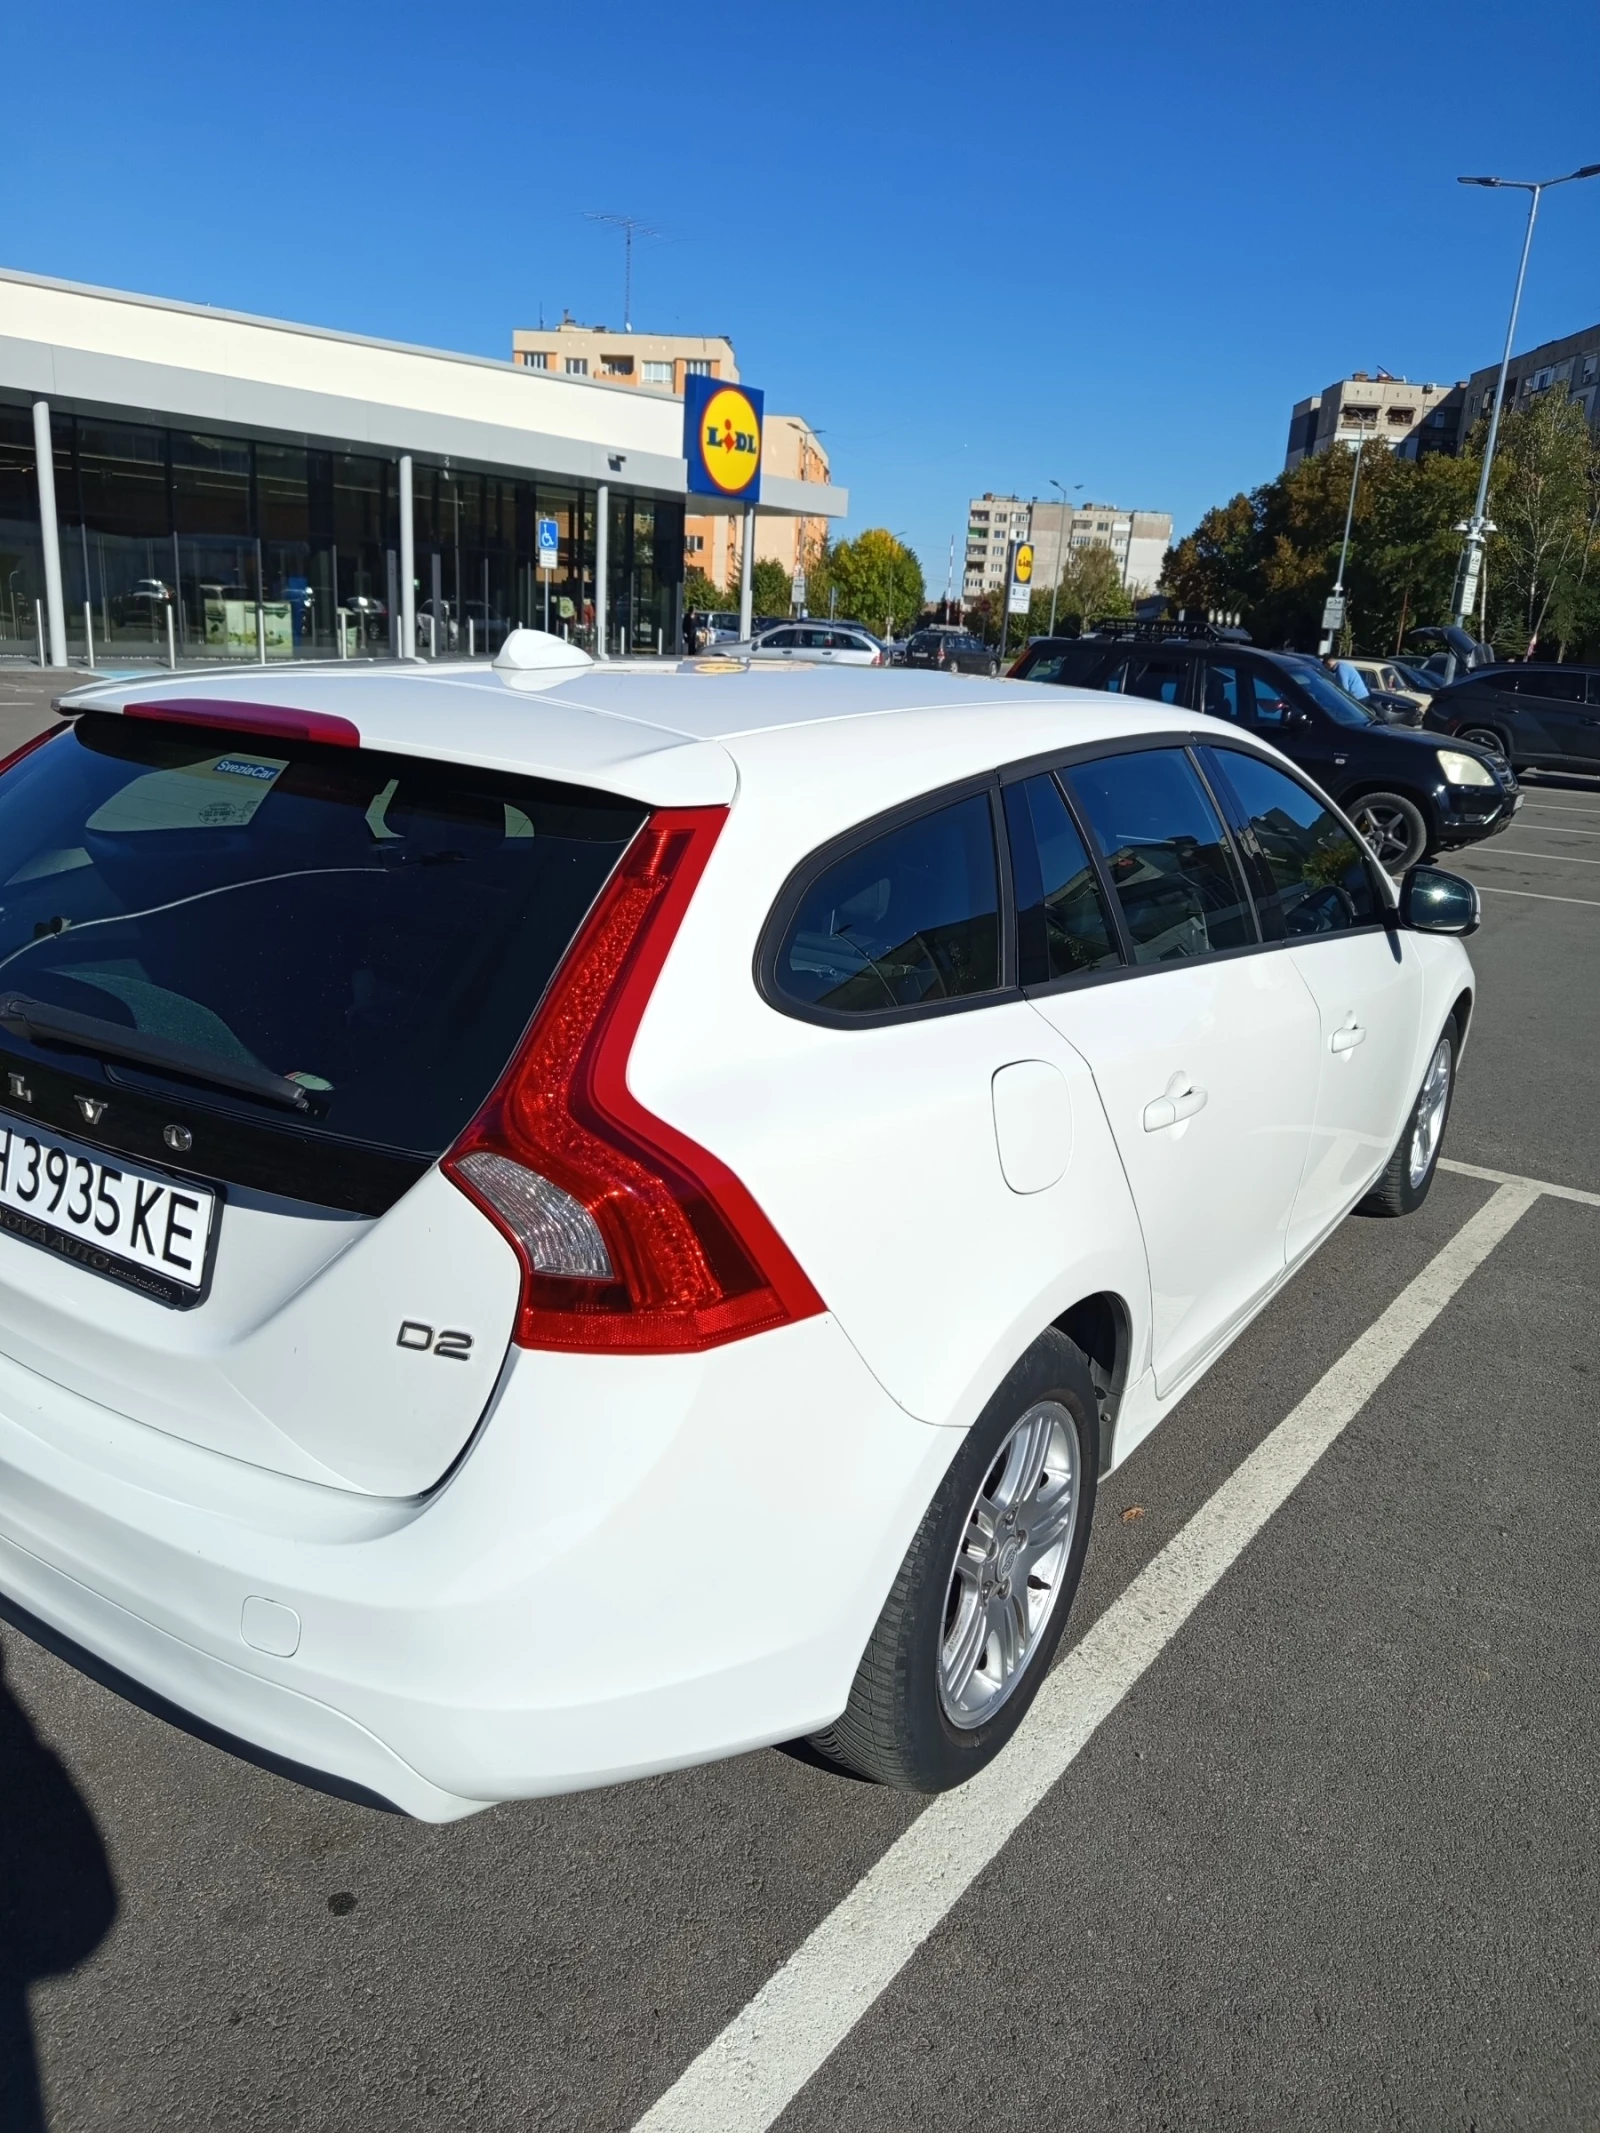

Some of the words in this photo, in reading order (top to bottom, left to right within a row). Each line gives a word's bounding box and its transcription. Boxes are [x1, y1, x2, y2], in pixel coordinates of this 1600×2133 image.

[216, 760, 276, 779] SveziaCar
[48, 1234, 110, 1269] AUTO
[396, 1319, 475, 1361] D2
